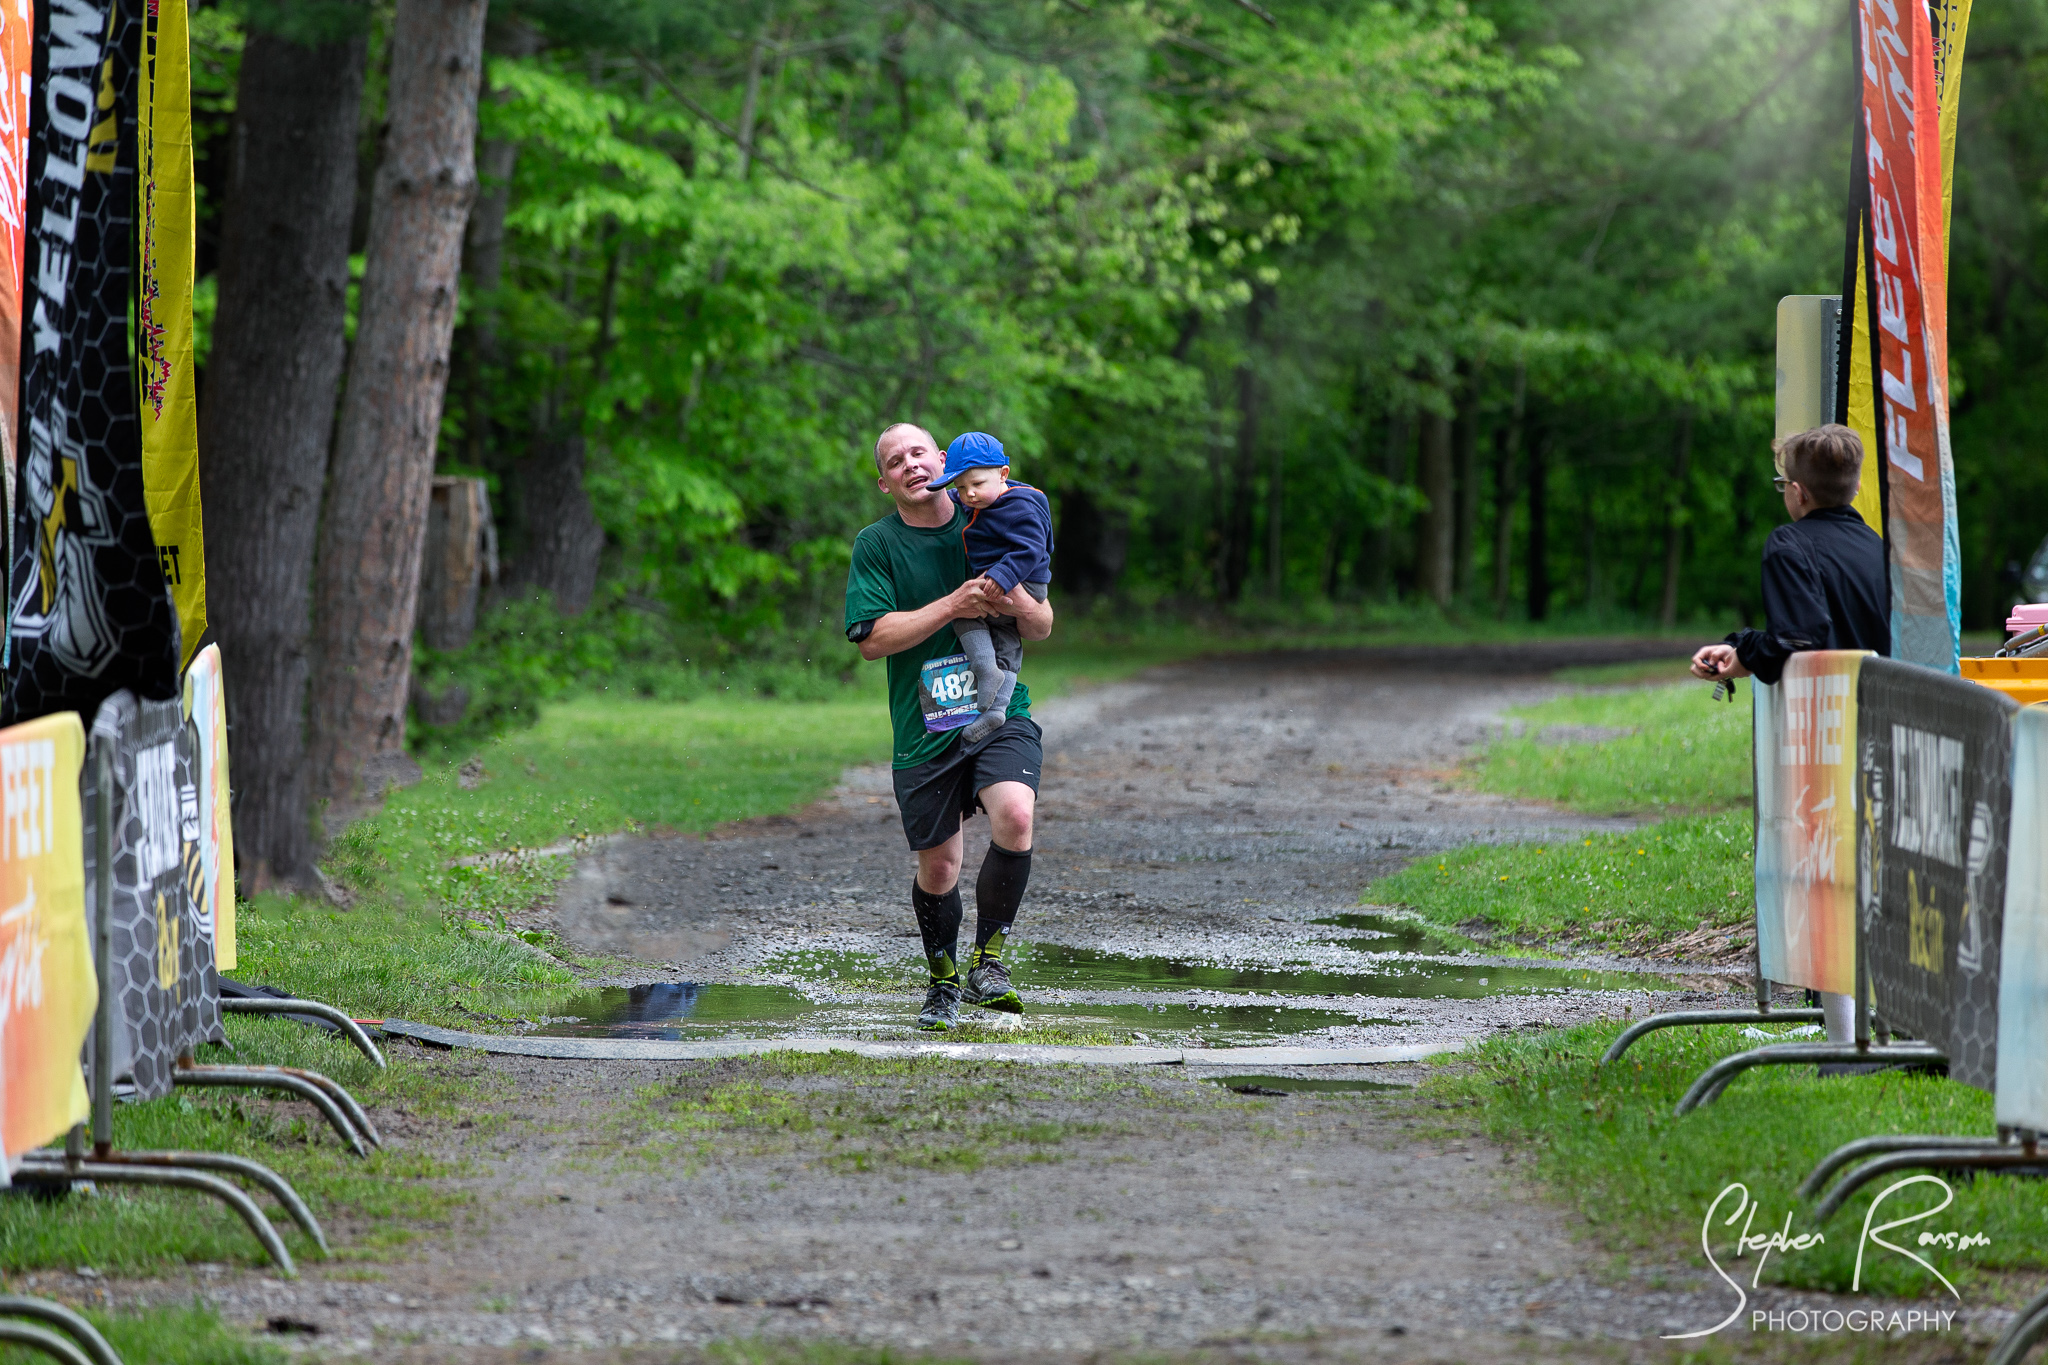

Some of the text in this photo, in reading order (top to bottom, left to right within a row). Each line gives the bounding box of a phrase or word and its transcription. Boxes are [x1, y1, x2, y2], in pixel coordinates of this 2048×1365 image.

[1864, 107, 1925, 482] FLEET
[931, 670, 978, 702] 482
[943, 656, 964, 666] Falls
[1815, 674, 1850, 765] FEET
[1, 738, 55, 862] FEET
